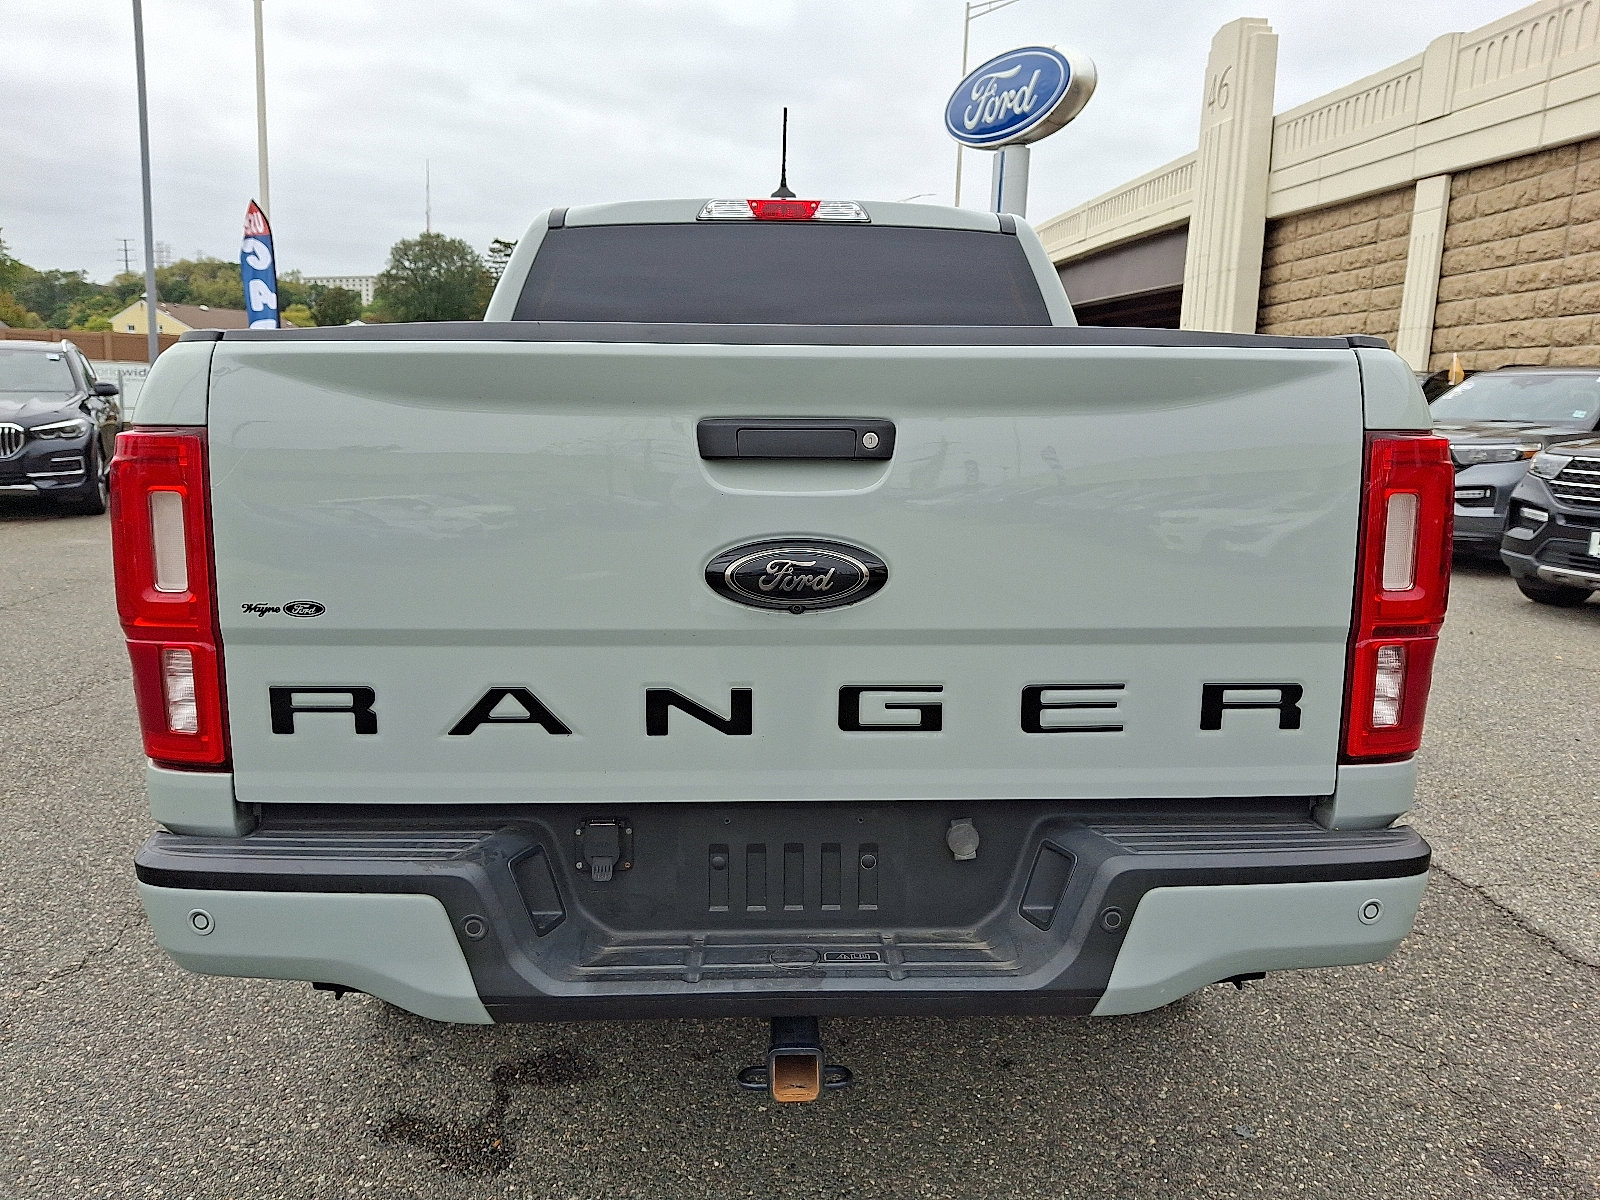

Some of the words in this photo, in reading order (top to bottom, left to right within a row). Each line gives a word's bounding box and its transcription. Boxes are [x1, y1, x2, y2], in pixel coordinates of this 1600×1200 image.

[964, 64, 1041, 129] Ford
[1208, 65, 1232, 114] 46
[758, 560, 836, 592] Ford
[241, 602, 280, 617] Wayne
[291, 603, 317, 614] Ford
[269, 684, 1304, 737] RANGER
